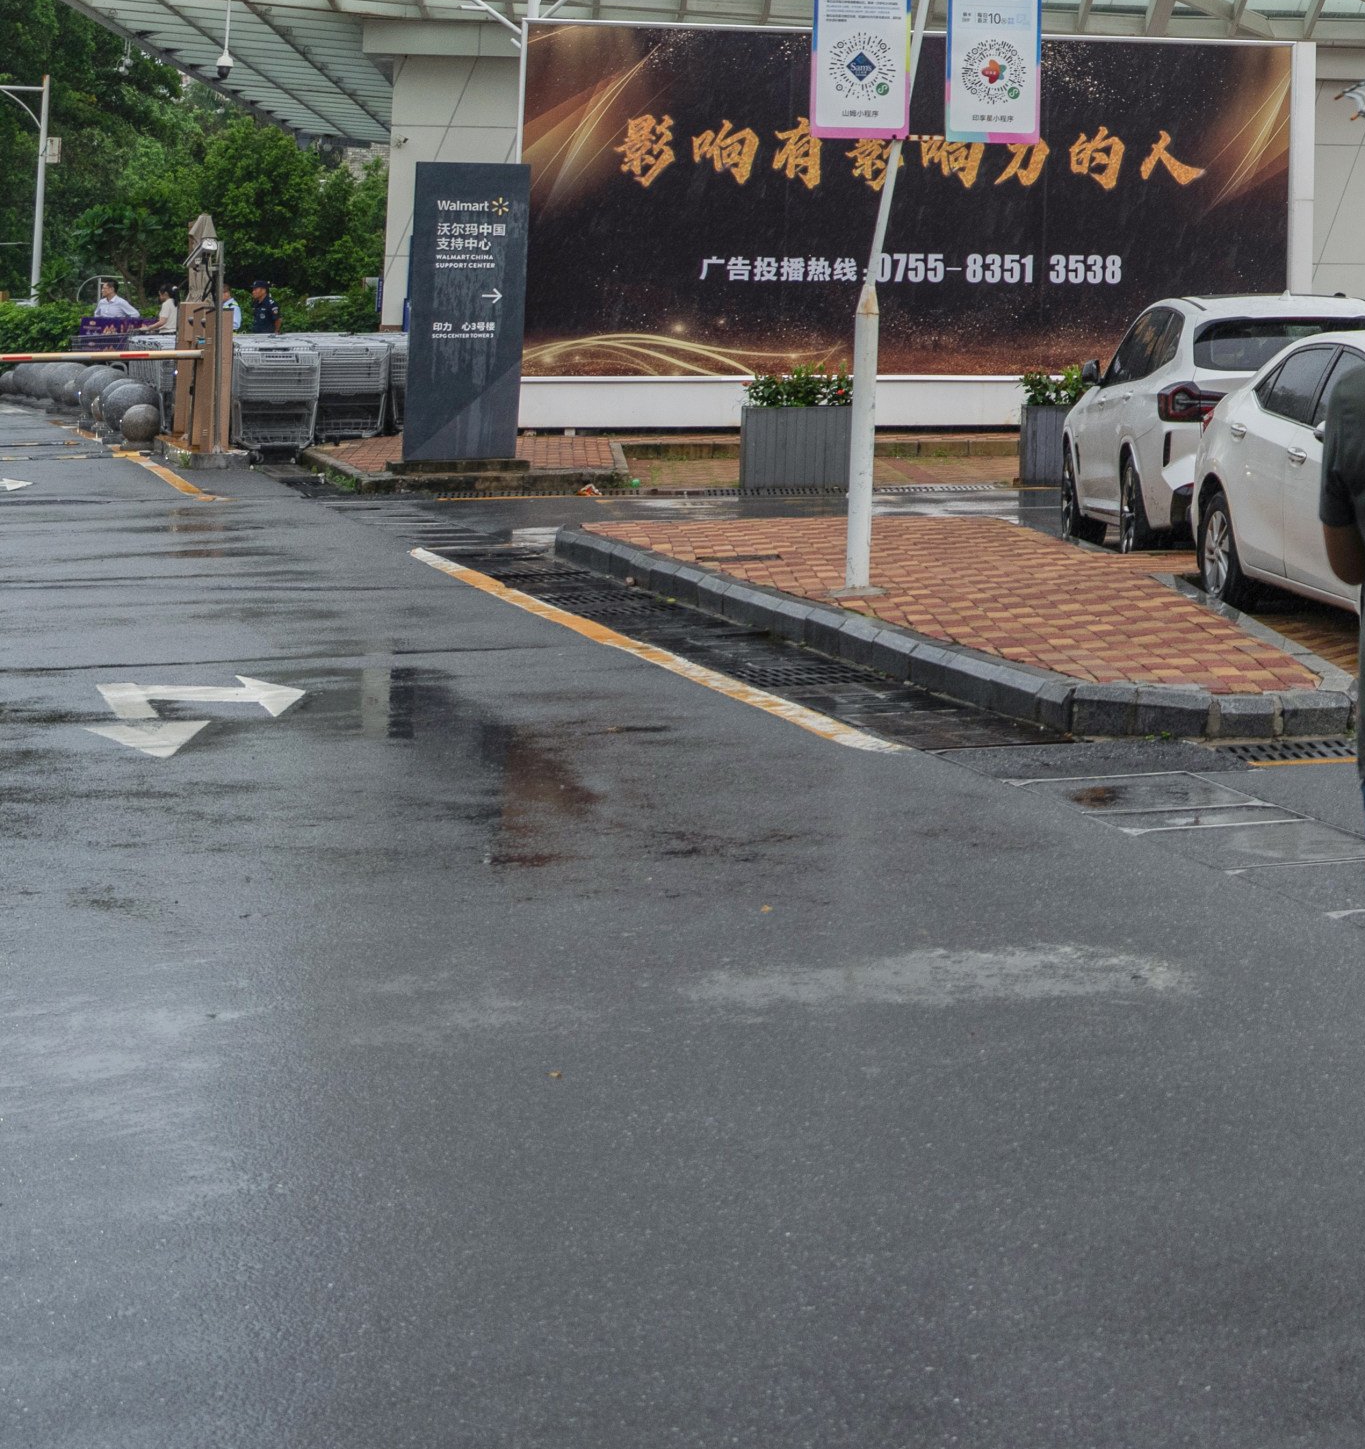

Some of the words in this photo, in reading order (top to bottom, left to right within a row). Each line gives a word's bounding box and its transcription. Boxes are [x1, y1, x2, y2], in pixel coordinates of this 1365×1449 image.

[842, 110, 879, 118] 山姆小程序
[437, 200, 490, 212] Walmart
[437, 222, 506, 236] 沃尔玛中国
[436, 237, 491, 250] 支持中心
[1049, 255, 1123, 284] 3538
